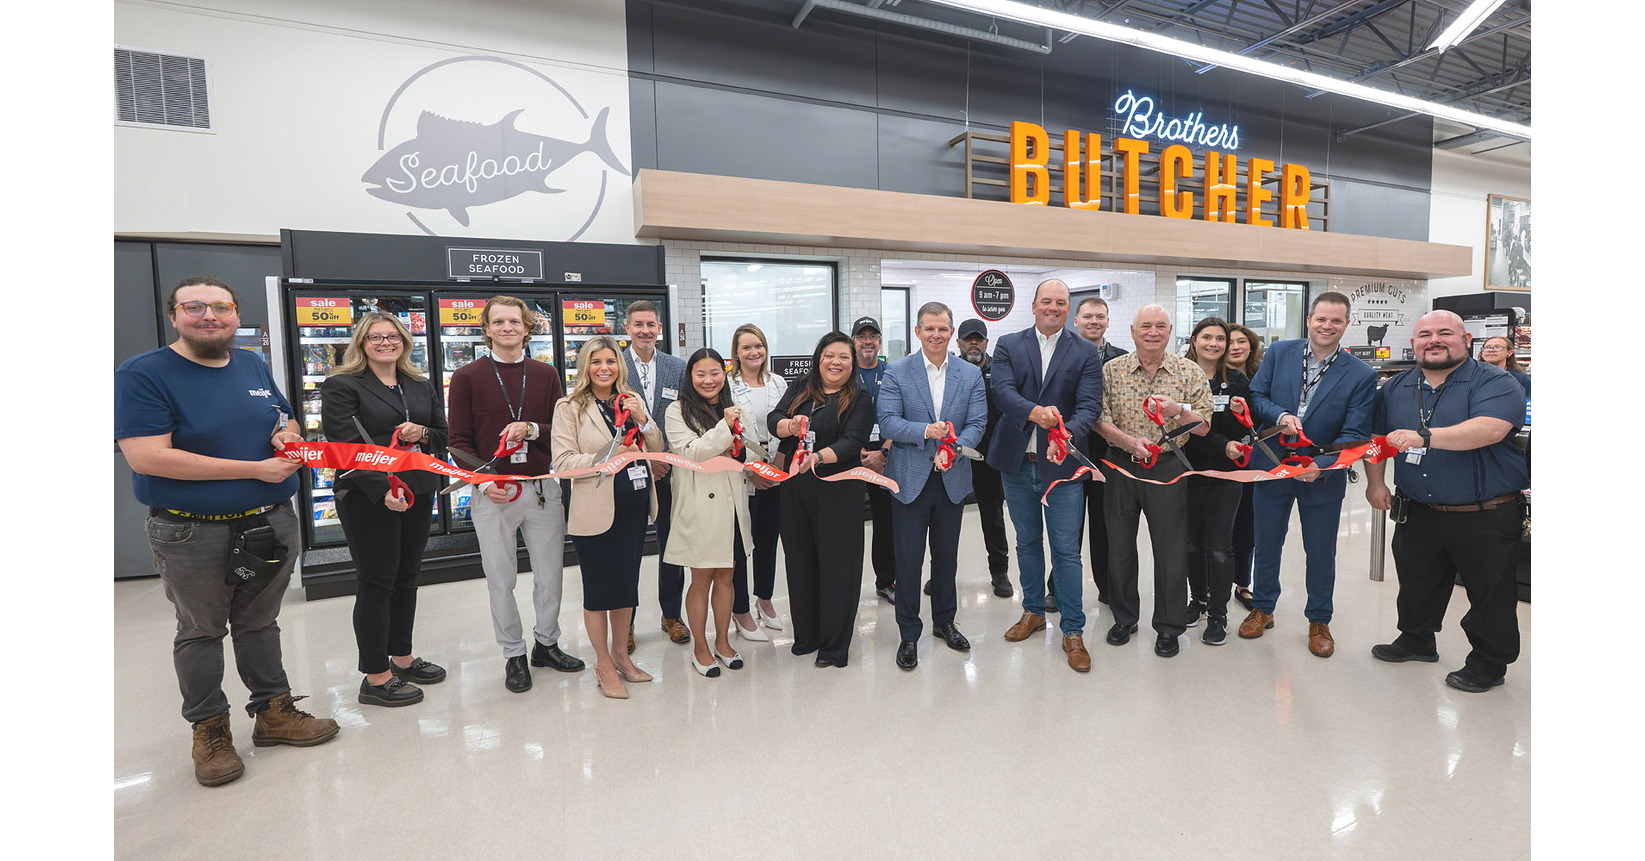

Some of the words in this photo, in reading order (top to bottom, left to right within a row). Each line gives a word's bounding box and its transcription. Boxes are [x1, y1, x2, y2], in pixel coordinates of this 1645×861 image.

[1114, 90, 1239, 150] Brothers
[386, 141, 552, 194] Seafood
[1009, 121, 1311, 230] BUTCHER
[473, 254, 520, 264] FROZEN
[468, 264, 525, 274] SEAFOOD
[984, 274, 1003, 287] Open
[1350, 282, 1385, 303] PREMIUM
[1387, 284, 1407, 304] CUTS
[310, 298, 336, 307] sale
[451, 300, 474, 308] sale
[573, 301, 594, 309] sale
[354, 449, 398, 466] meijer
[429, 462, 474, 479] meijer
